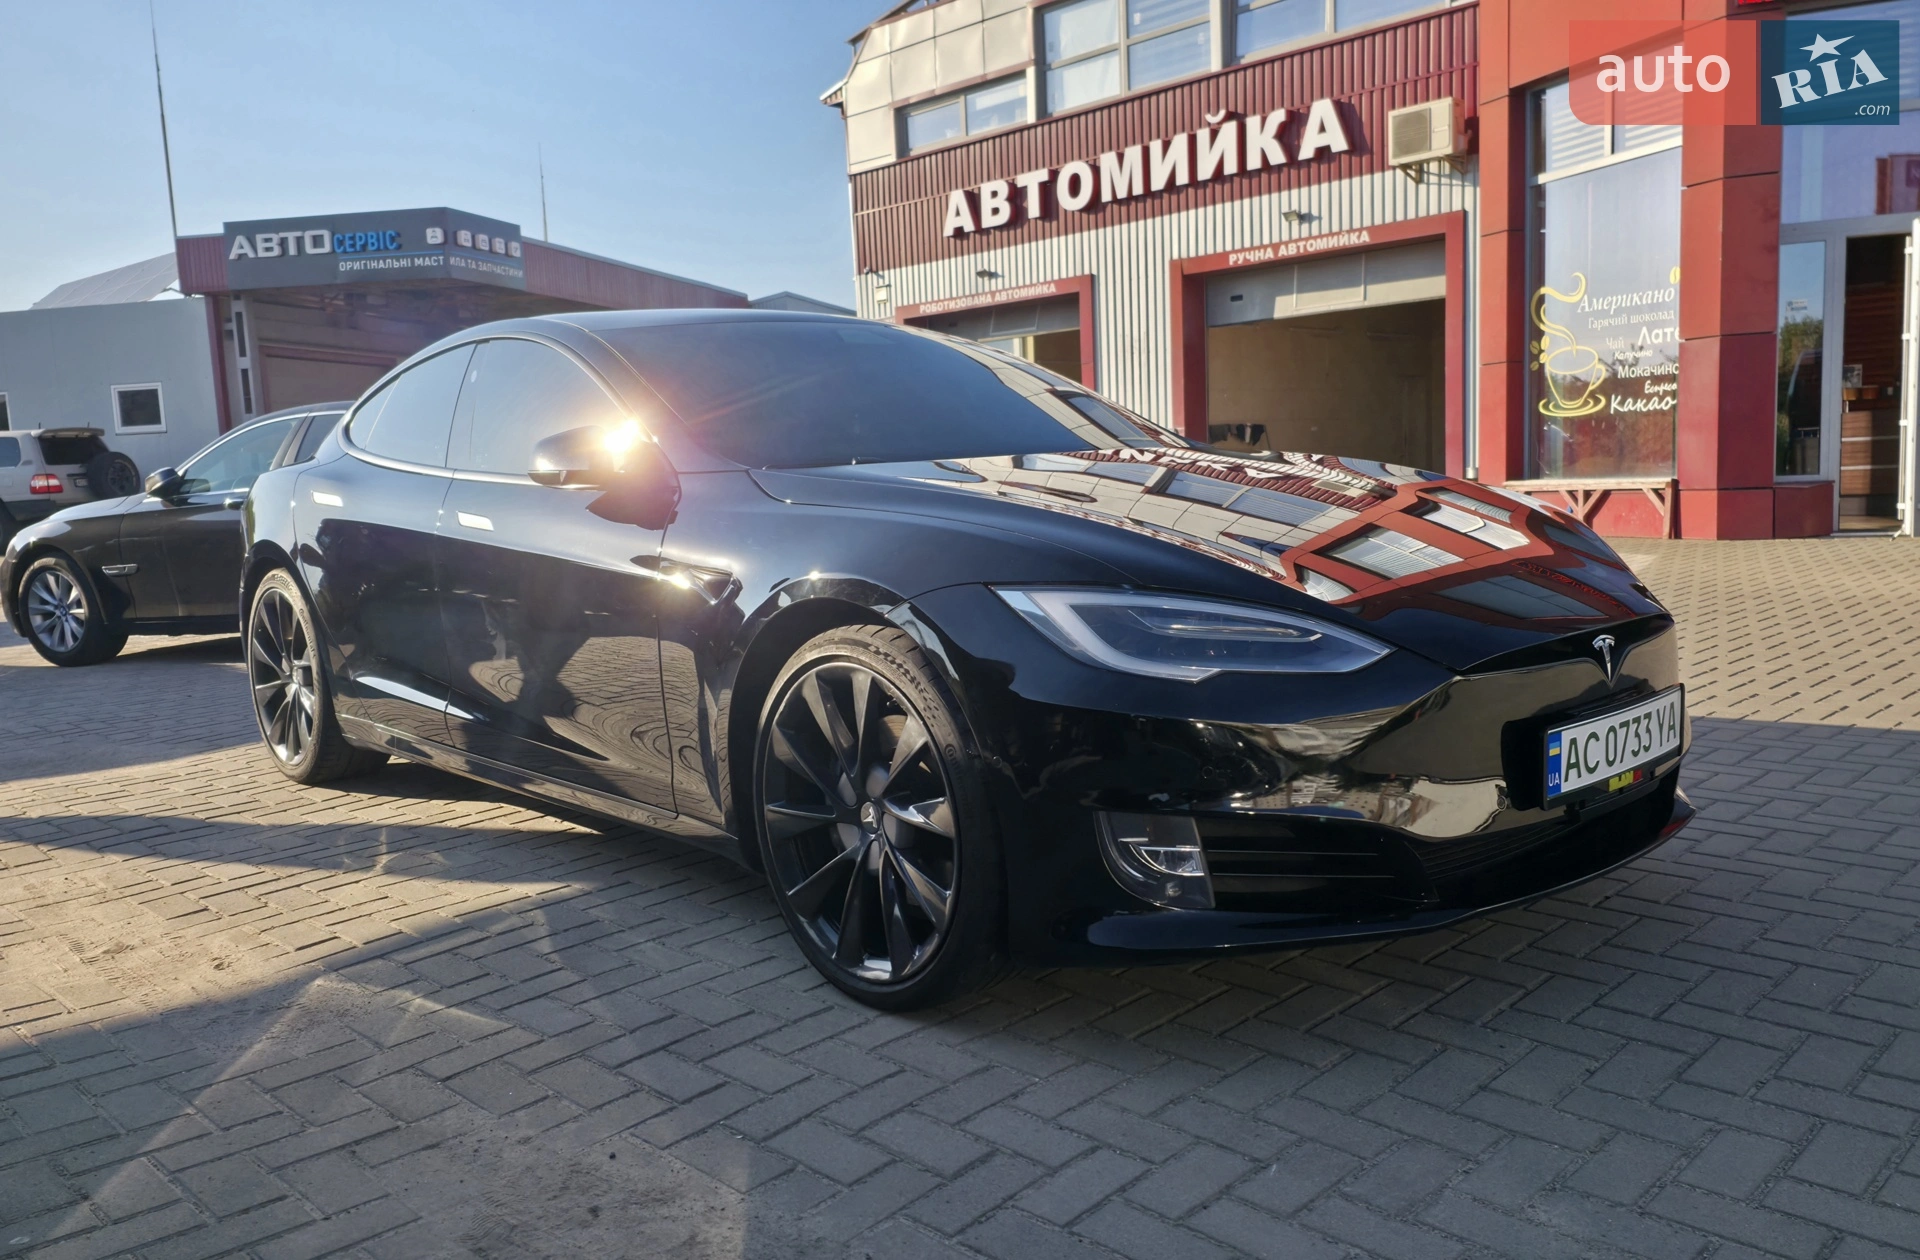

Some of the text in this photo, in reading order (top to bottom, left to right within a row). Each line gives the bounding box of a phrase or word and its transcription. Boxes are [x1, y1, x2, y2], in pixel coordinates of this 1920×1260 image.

[943, 97, 1352, 238] АВТОМИЙКА
[1228, 230, 1370, 266] РУЧНА АВТОМИЙКА
[339, 258, 411, 271] ОРИГІНАЛЬНІ
[467, 259, 477, 270] ТА
[478, 261, 524, 278] ЗАПЧАСТИНИ
[919, 283, 1057, 314] РОБОТИЗОВАНА АВТОМИЙКА
[1577, 287, 1676, 315] Американо
[1588, 310, 1675, 331] Гарячий шоколад
[1606, 336, 1625, 349] Чай
[1610, 393, 1678, 415] Какао
[1564, 731, 1600, 783] AC
[1605, 711, 1652, 768] 0733
[1656, 701, 1677, 748] YA
[1548, 773, 1561, 787] UA
